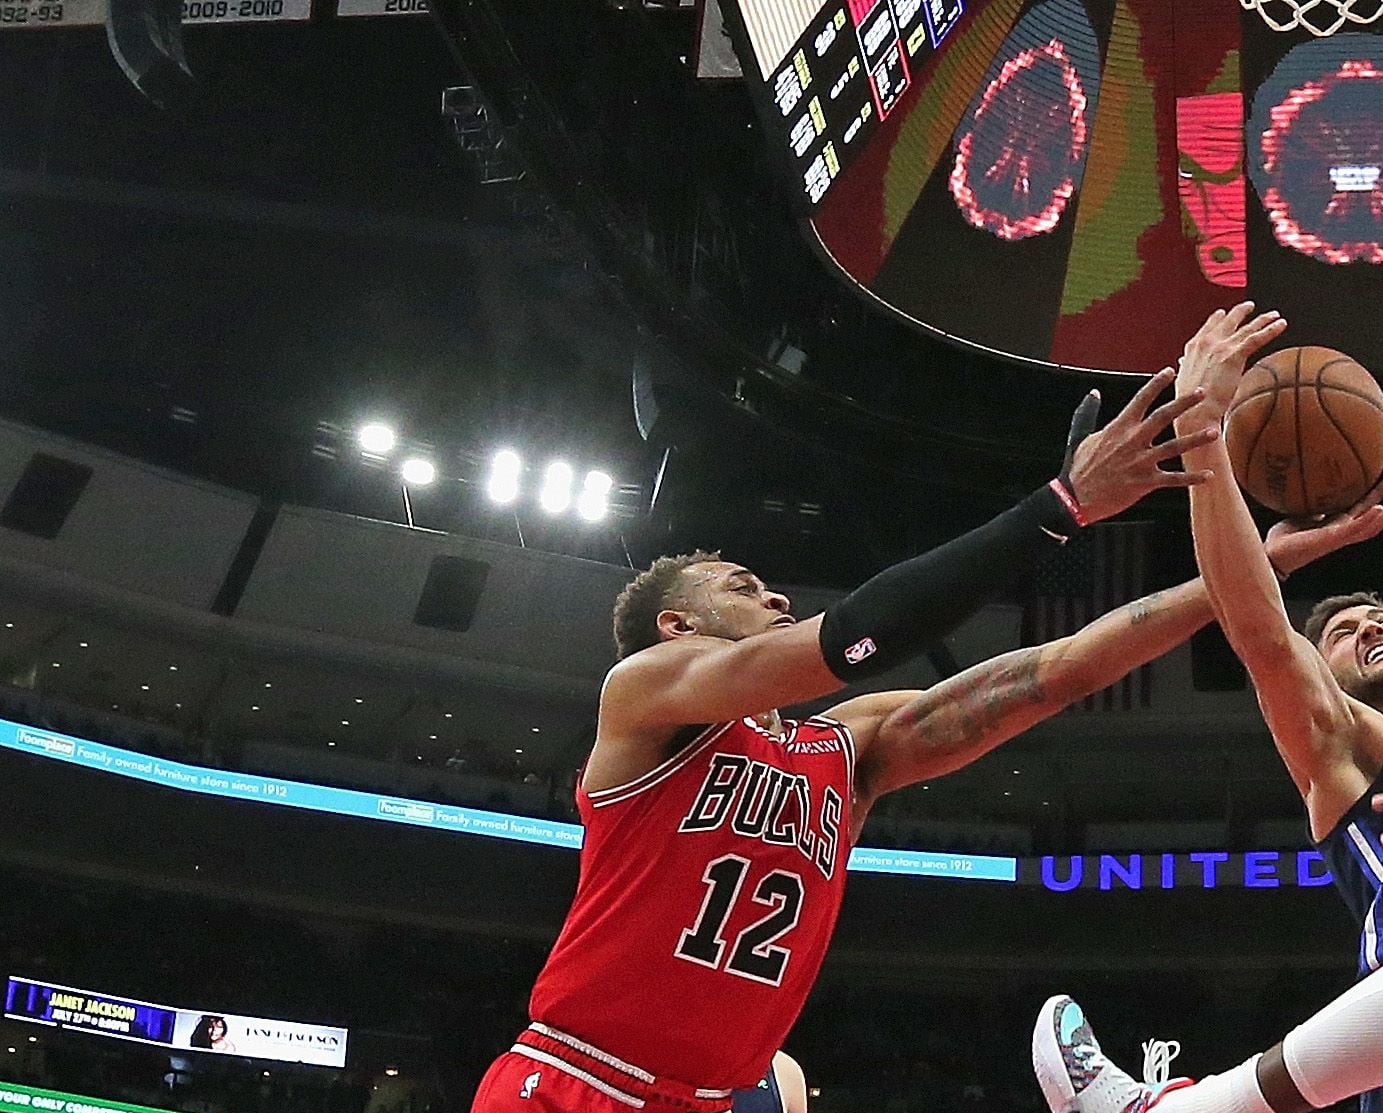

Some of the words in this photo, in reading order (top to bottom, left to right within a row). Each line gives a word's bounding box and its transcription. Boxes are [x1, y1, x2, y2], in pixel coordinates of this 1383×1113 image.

[77, 744, 111, 766] Family
[114, 757, 152, 774] owned
[153, 765, 198, 785] furniture
[262, 783, 288, 797] 1912
[678, 753, 842, 881] BULLS
[950, 859, 973, 872] 1912
[1041, 852, 1334, 892] UNITED
[674, 853, 805, 987] 12
[49, 992, 85, 1012] JANET
[85, 999, 136, 1021] JACKSON
[31, 1096, 66, 1111] ONLY
